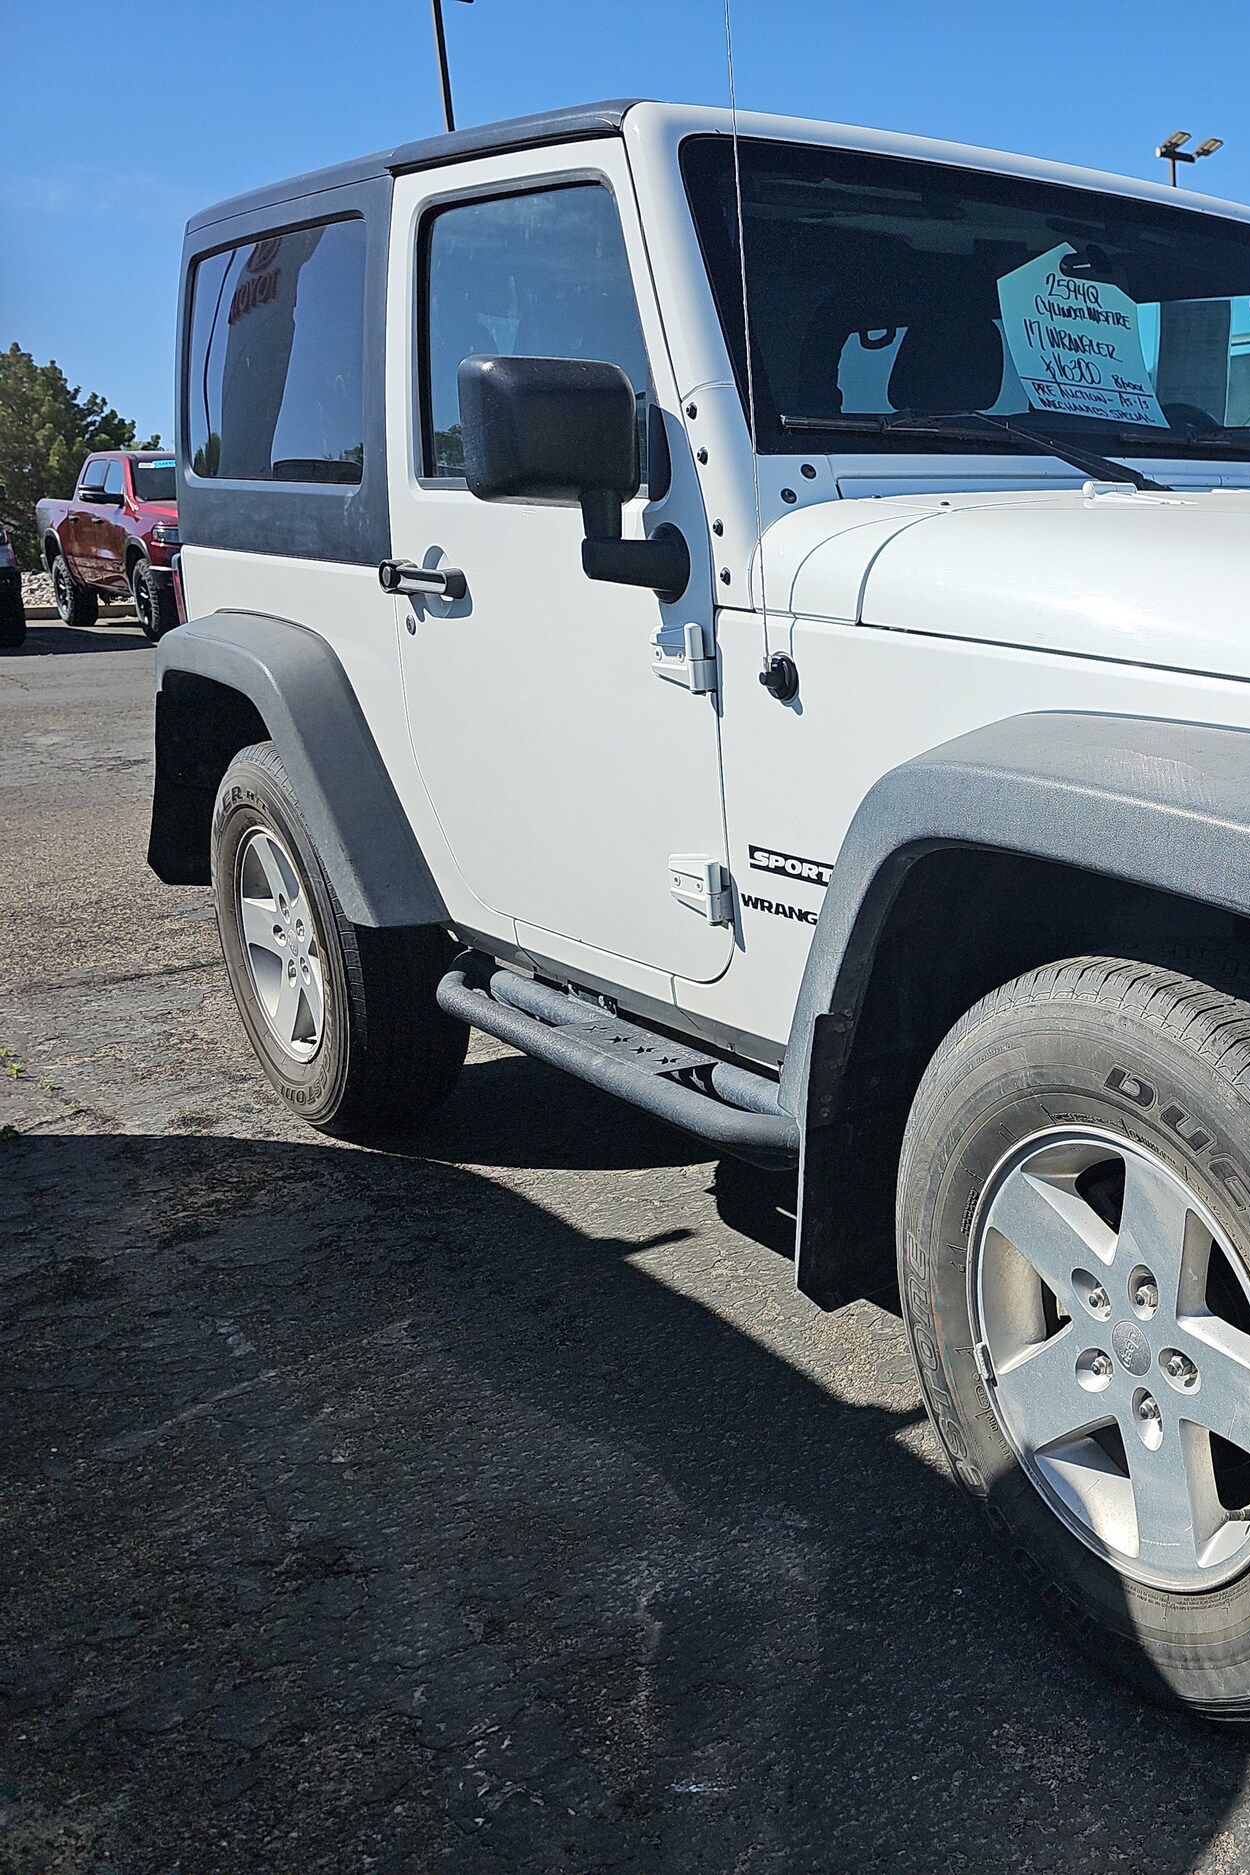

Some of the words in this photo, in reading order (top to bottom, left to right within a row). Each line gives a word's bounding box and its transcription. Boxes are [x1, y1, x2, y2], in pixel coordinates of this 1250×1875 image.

[1046, 273, 1102, 309] 2594Q
[1045, 326, 1123, 363] WRANGLER
[752, 851, 833, 883] SPORT
